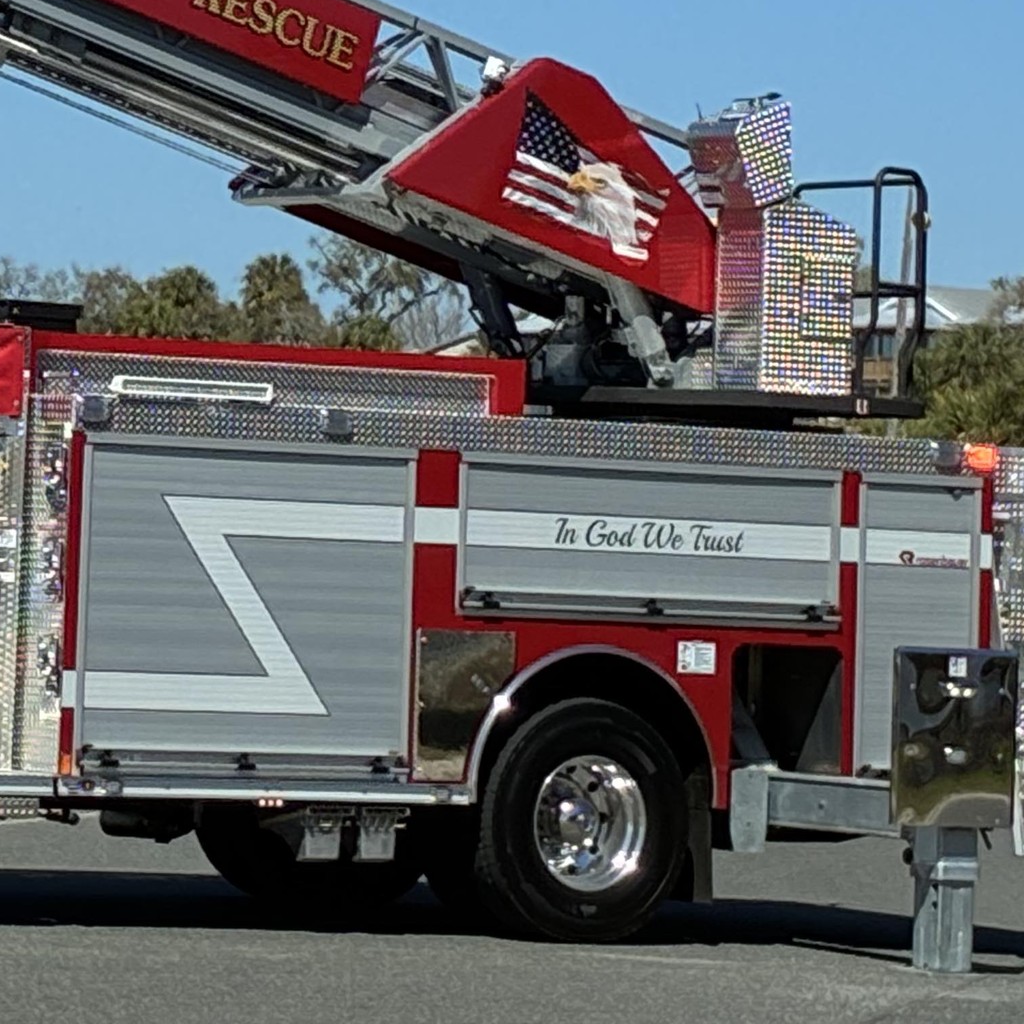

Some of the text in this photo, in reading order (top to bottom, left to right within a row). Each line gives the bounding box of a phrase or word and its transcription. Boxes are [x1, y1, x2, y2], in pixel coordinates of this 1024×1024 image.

[555, 517, 745, 553] In God We Trust
